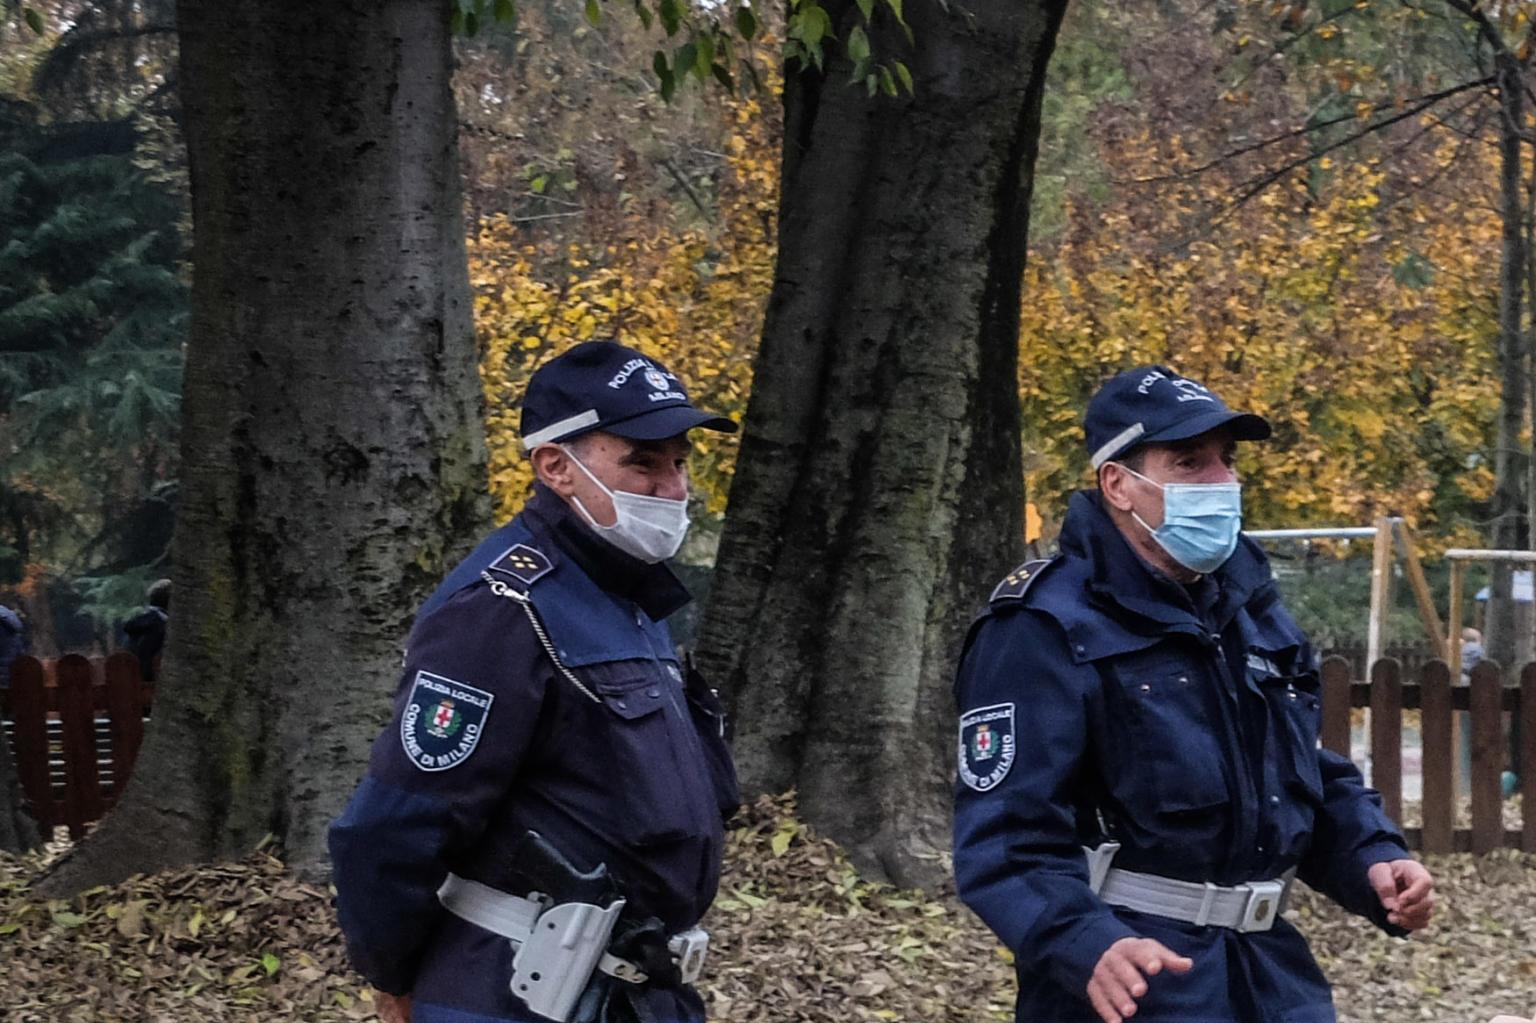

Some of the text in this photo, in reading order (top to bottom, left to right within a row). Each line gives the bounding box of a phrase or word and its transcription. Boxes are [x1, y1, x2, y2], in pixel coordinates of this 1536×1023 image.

[452, 689, 488, 708] LOCALE
[403, 703, 478, 767] COMUNE DI MILANO
